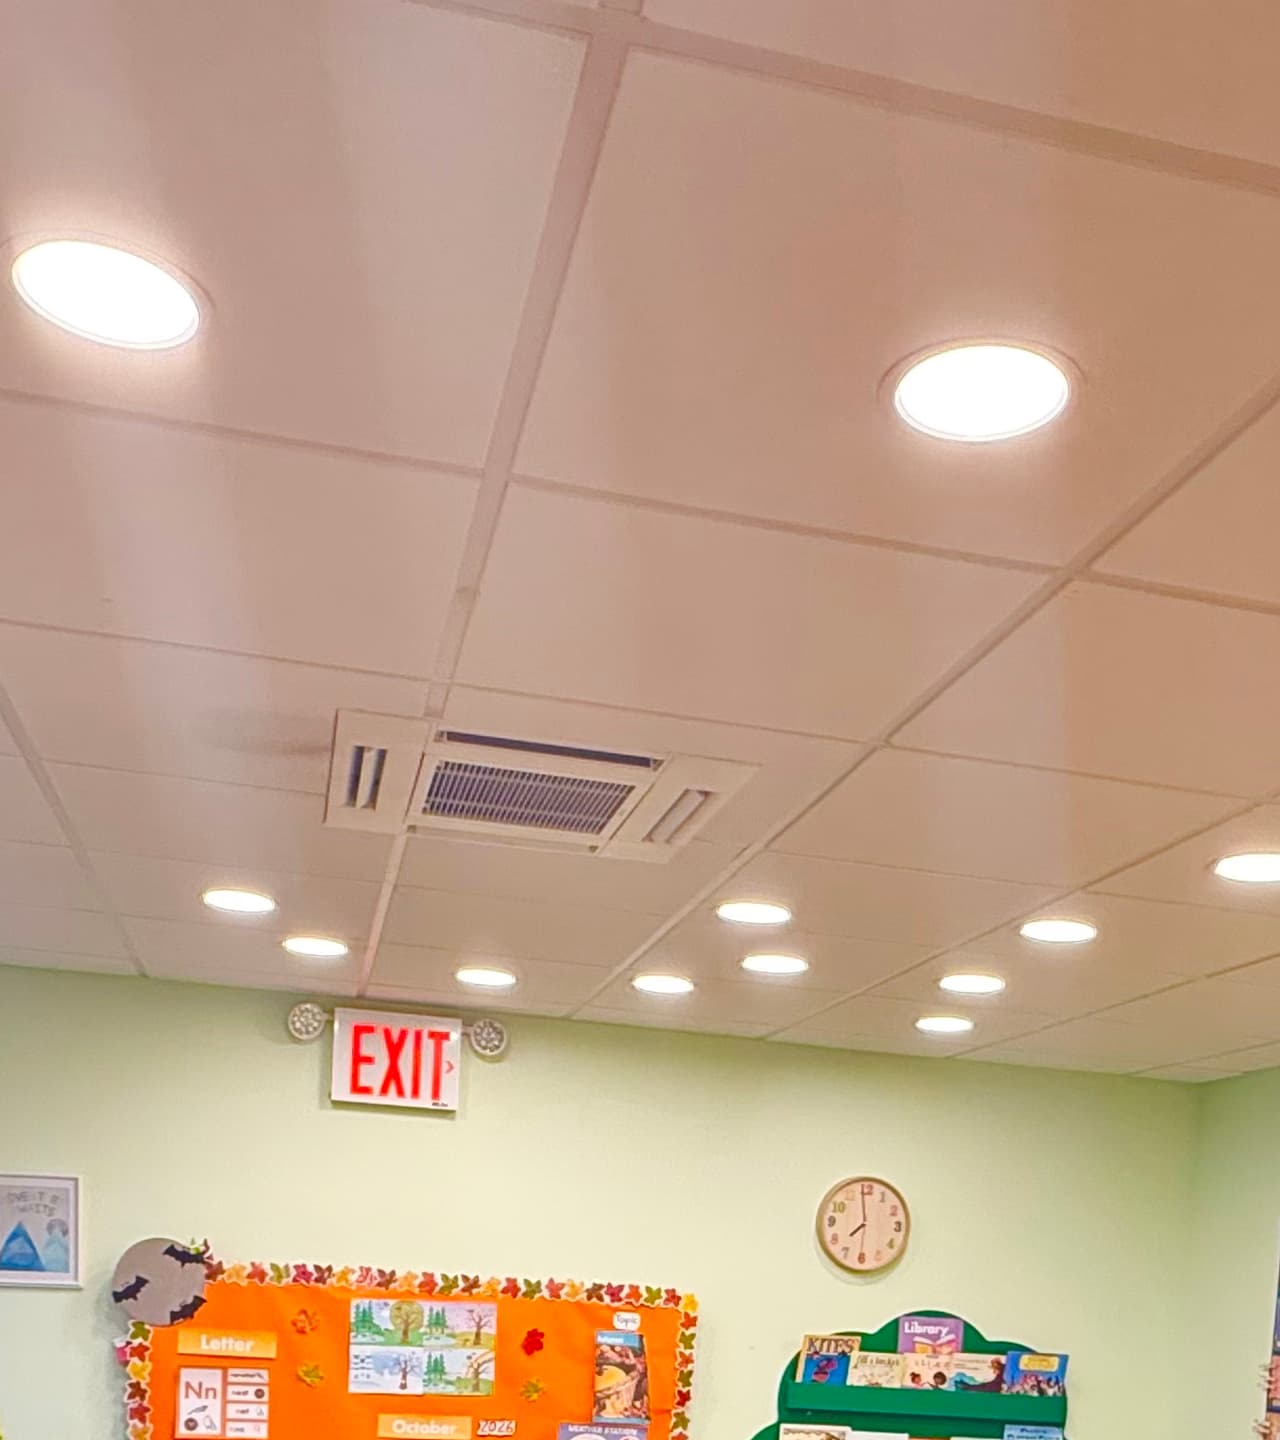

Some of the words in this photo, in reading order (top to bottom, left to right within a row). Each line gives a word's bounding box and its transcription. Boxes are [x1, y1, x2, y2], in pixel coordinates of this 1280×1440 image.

[350, 1024, 450, 1100] EXIT
[832, 1201, 846, 1213] 10
[889, 1205, 898, 1216] 2
[827, 1215, 836, 1228] 9
[894, 1221, 902, 1232] 3
[841, 1247, 849, 1258] 7
[904, 1321, 950, 1336] Library
[200, 1333, 255, 1352] Letter
[807, 1337, 856, 1353] KITES
[185, 1381, 217, 1399] Nn
[392, 1419, 457, 1435] October
[480, 1420, 514, 1433] 2026
